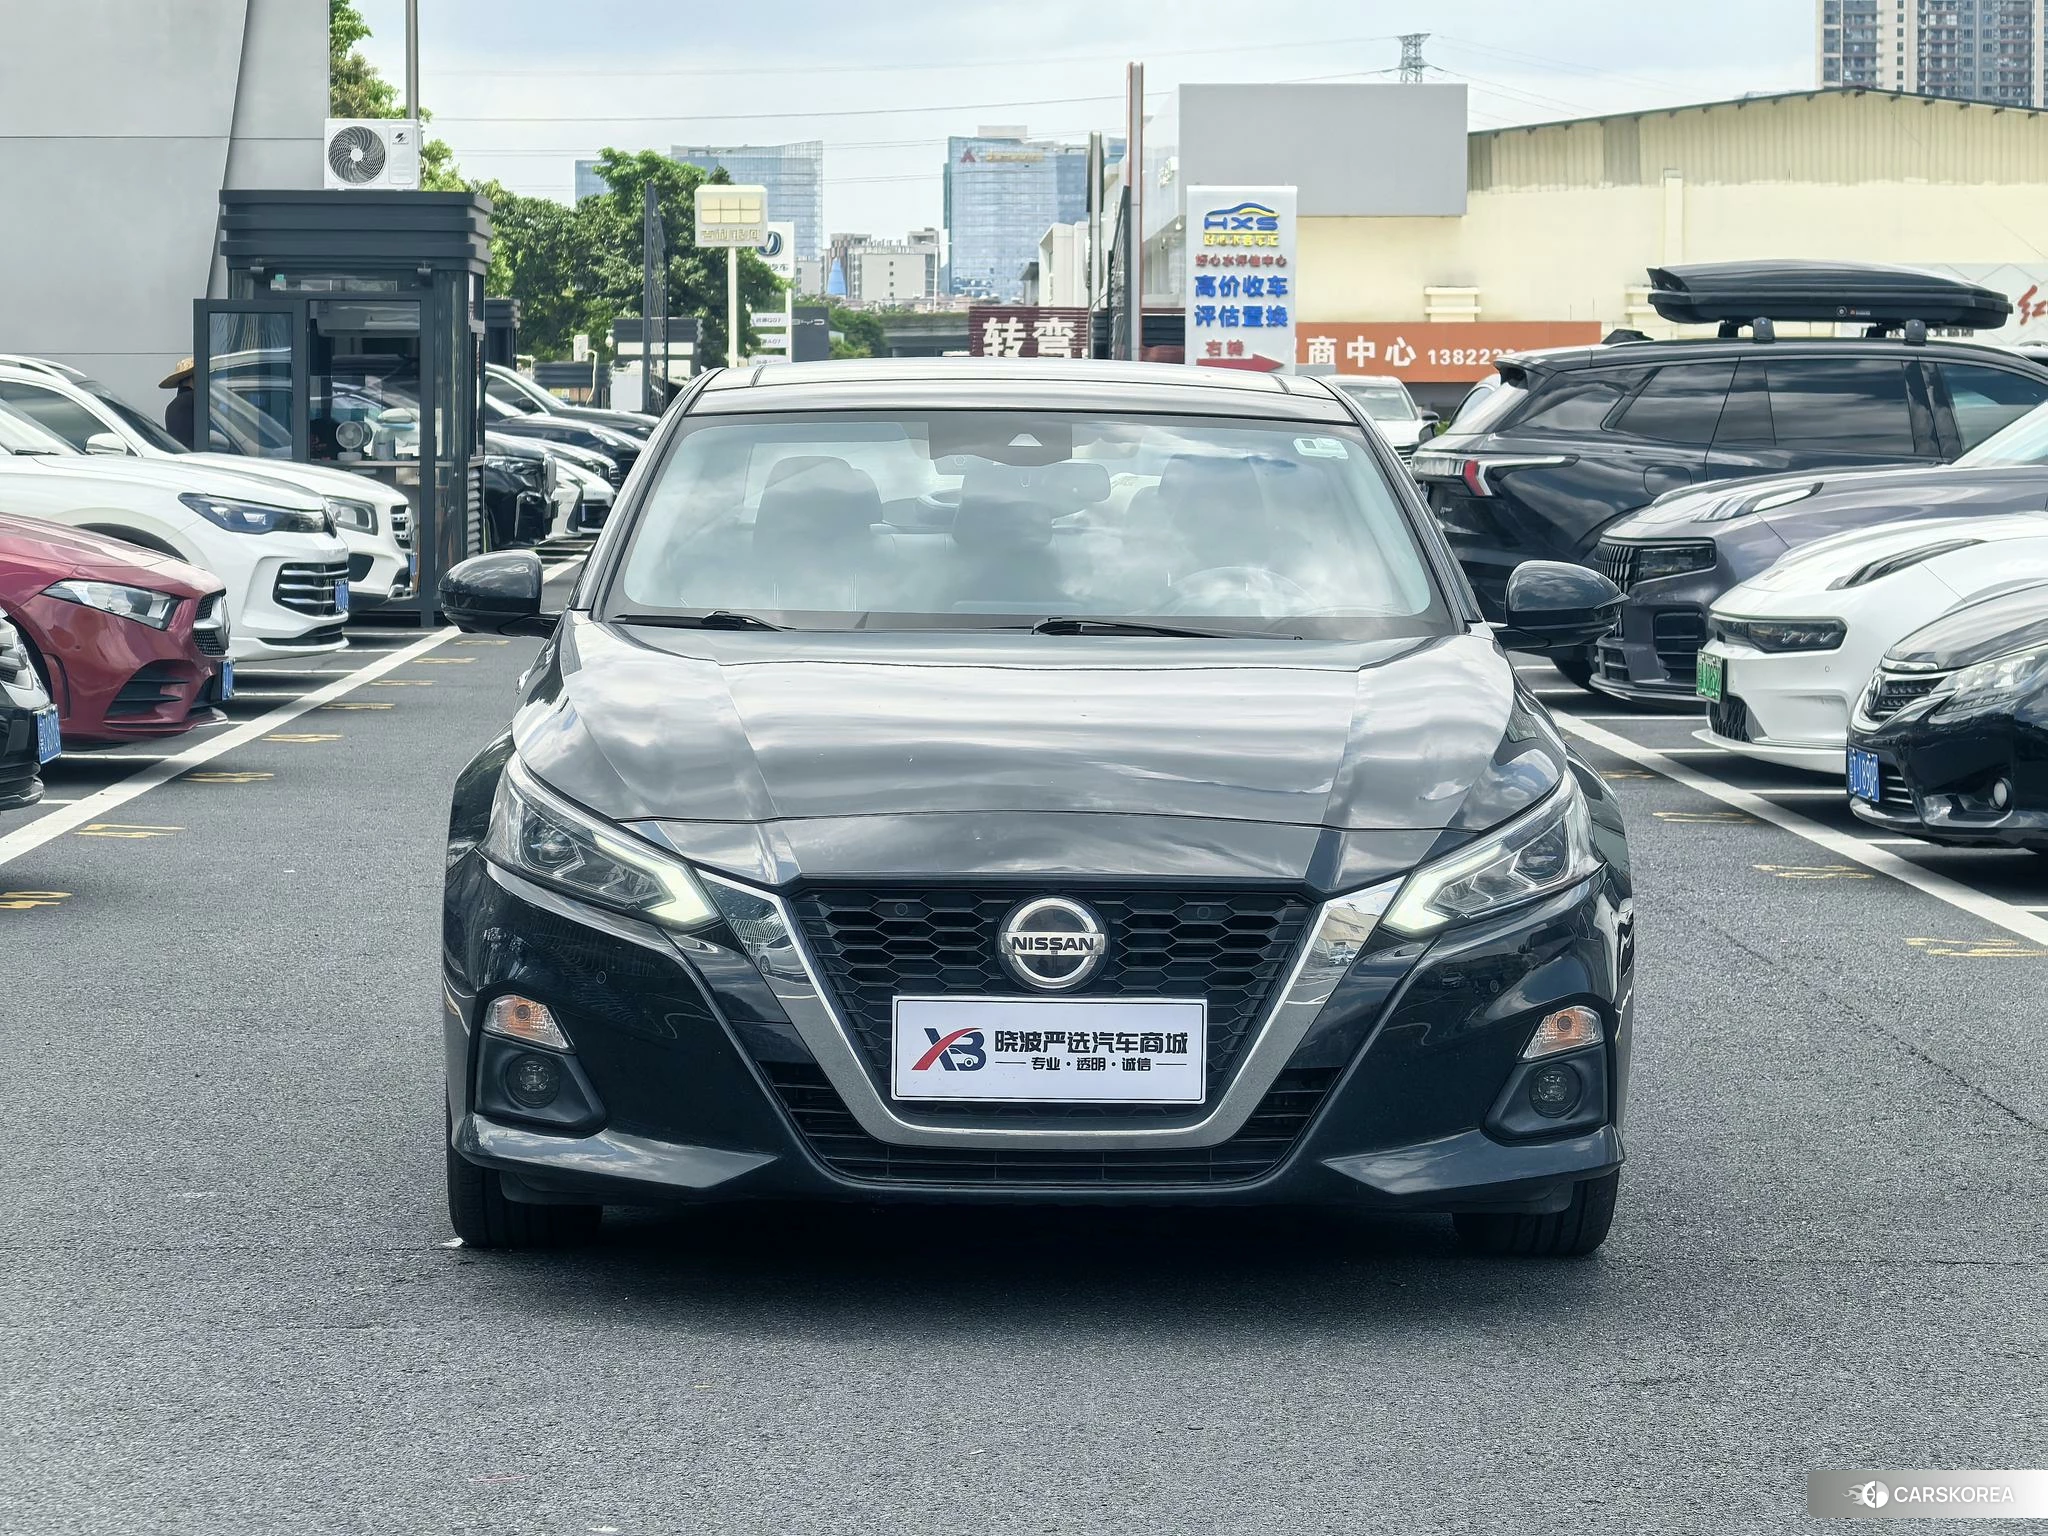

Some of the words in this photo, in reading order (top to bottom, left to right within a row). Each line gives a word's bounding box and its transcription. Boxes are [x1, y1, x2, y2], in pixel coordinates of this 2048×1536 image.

[1203, 216, 1279, 231] HXS
[1194, 275, 1288, 298] 高价收车
[1194, 304, 1288, 328] 评估置换
[1295, 336, 1417, 368] 商中心
[1012, 936, 1095, 951] NISSAN
[994, 1030, 1188, 1054] 晓波严选汽车商城
